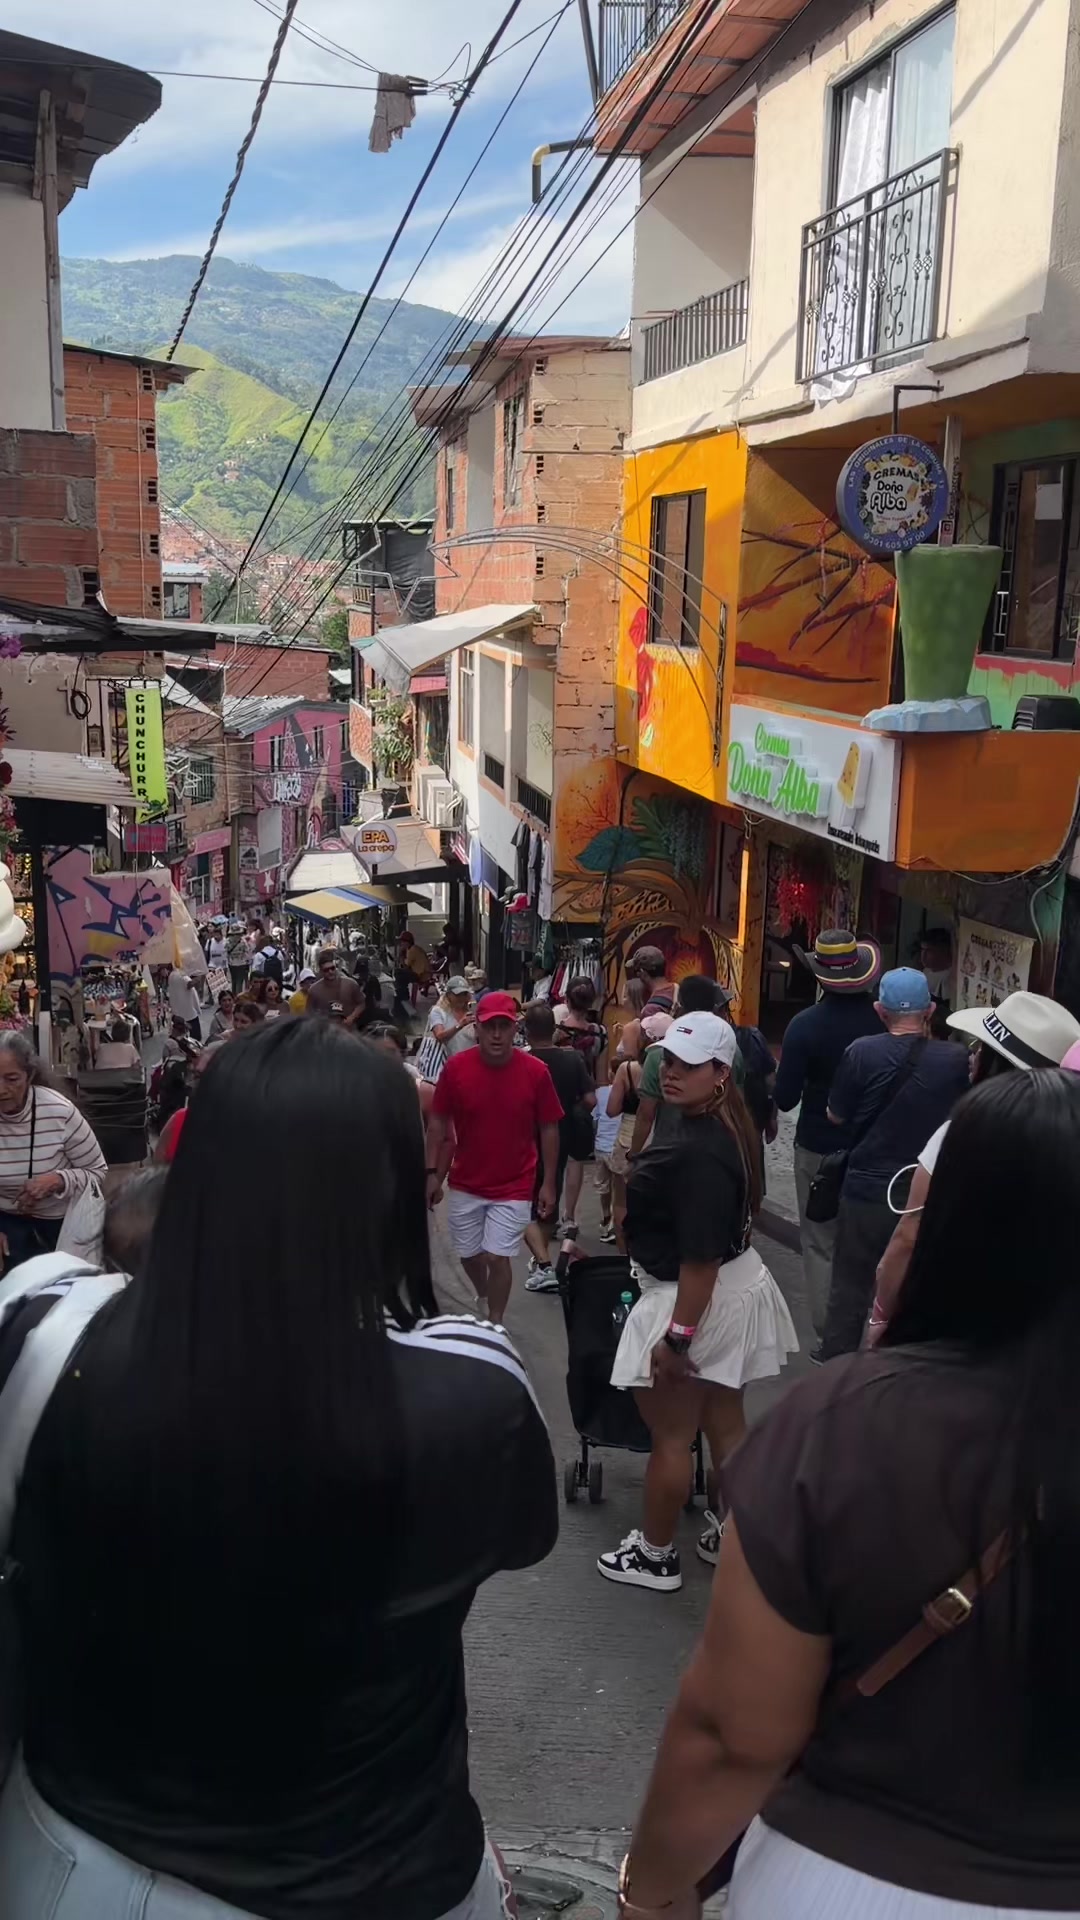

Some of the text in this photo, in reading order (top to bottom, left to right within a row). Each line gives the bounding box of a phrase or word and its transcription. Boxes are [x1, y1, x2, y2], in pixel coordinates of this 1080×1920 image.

[848, 470, 857, 488] LAS
[912, 439, 921, 447] LA
[873, 467, 921, 482] CREMAS
[877, 481, 904, 494] Doña
[870, 492, 907, 515] Alba
[755, 723, 789, 757] Cremas
[771, 758, 820, 818] Alba
[363, 830, 389, 843] EPA
[369, 845, 394, 853] arepa
